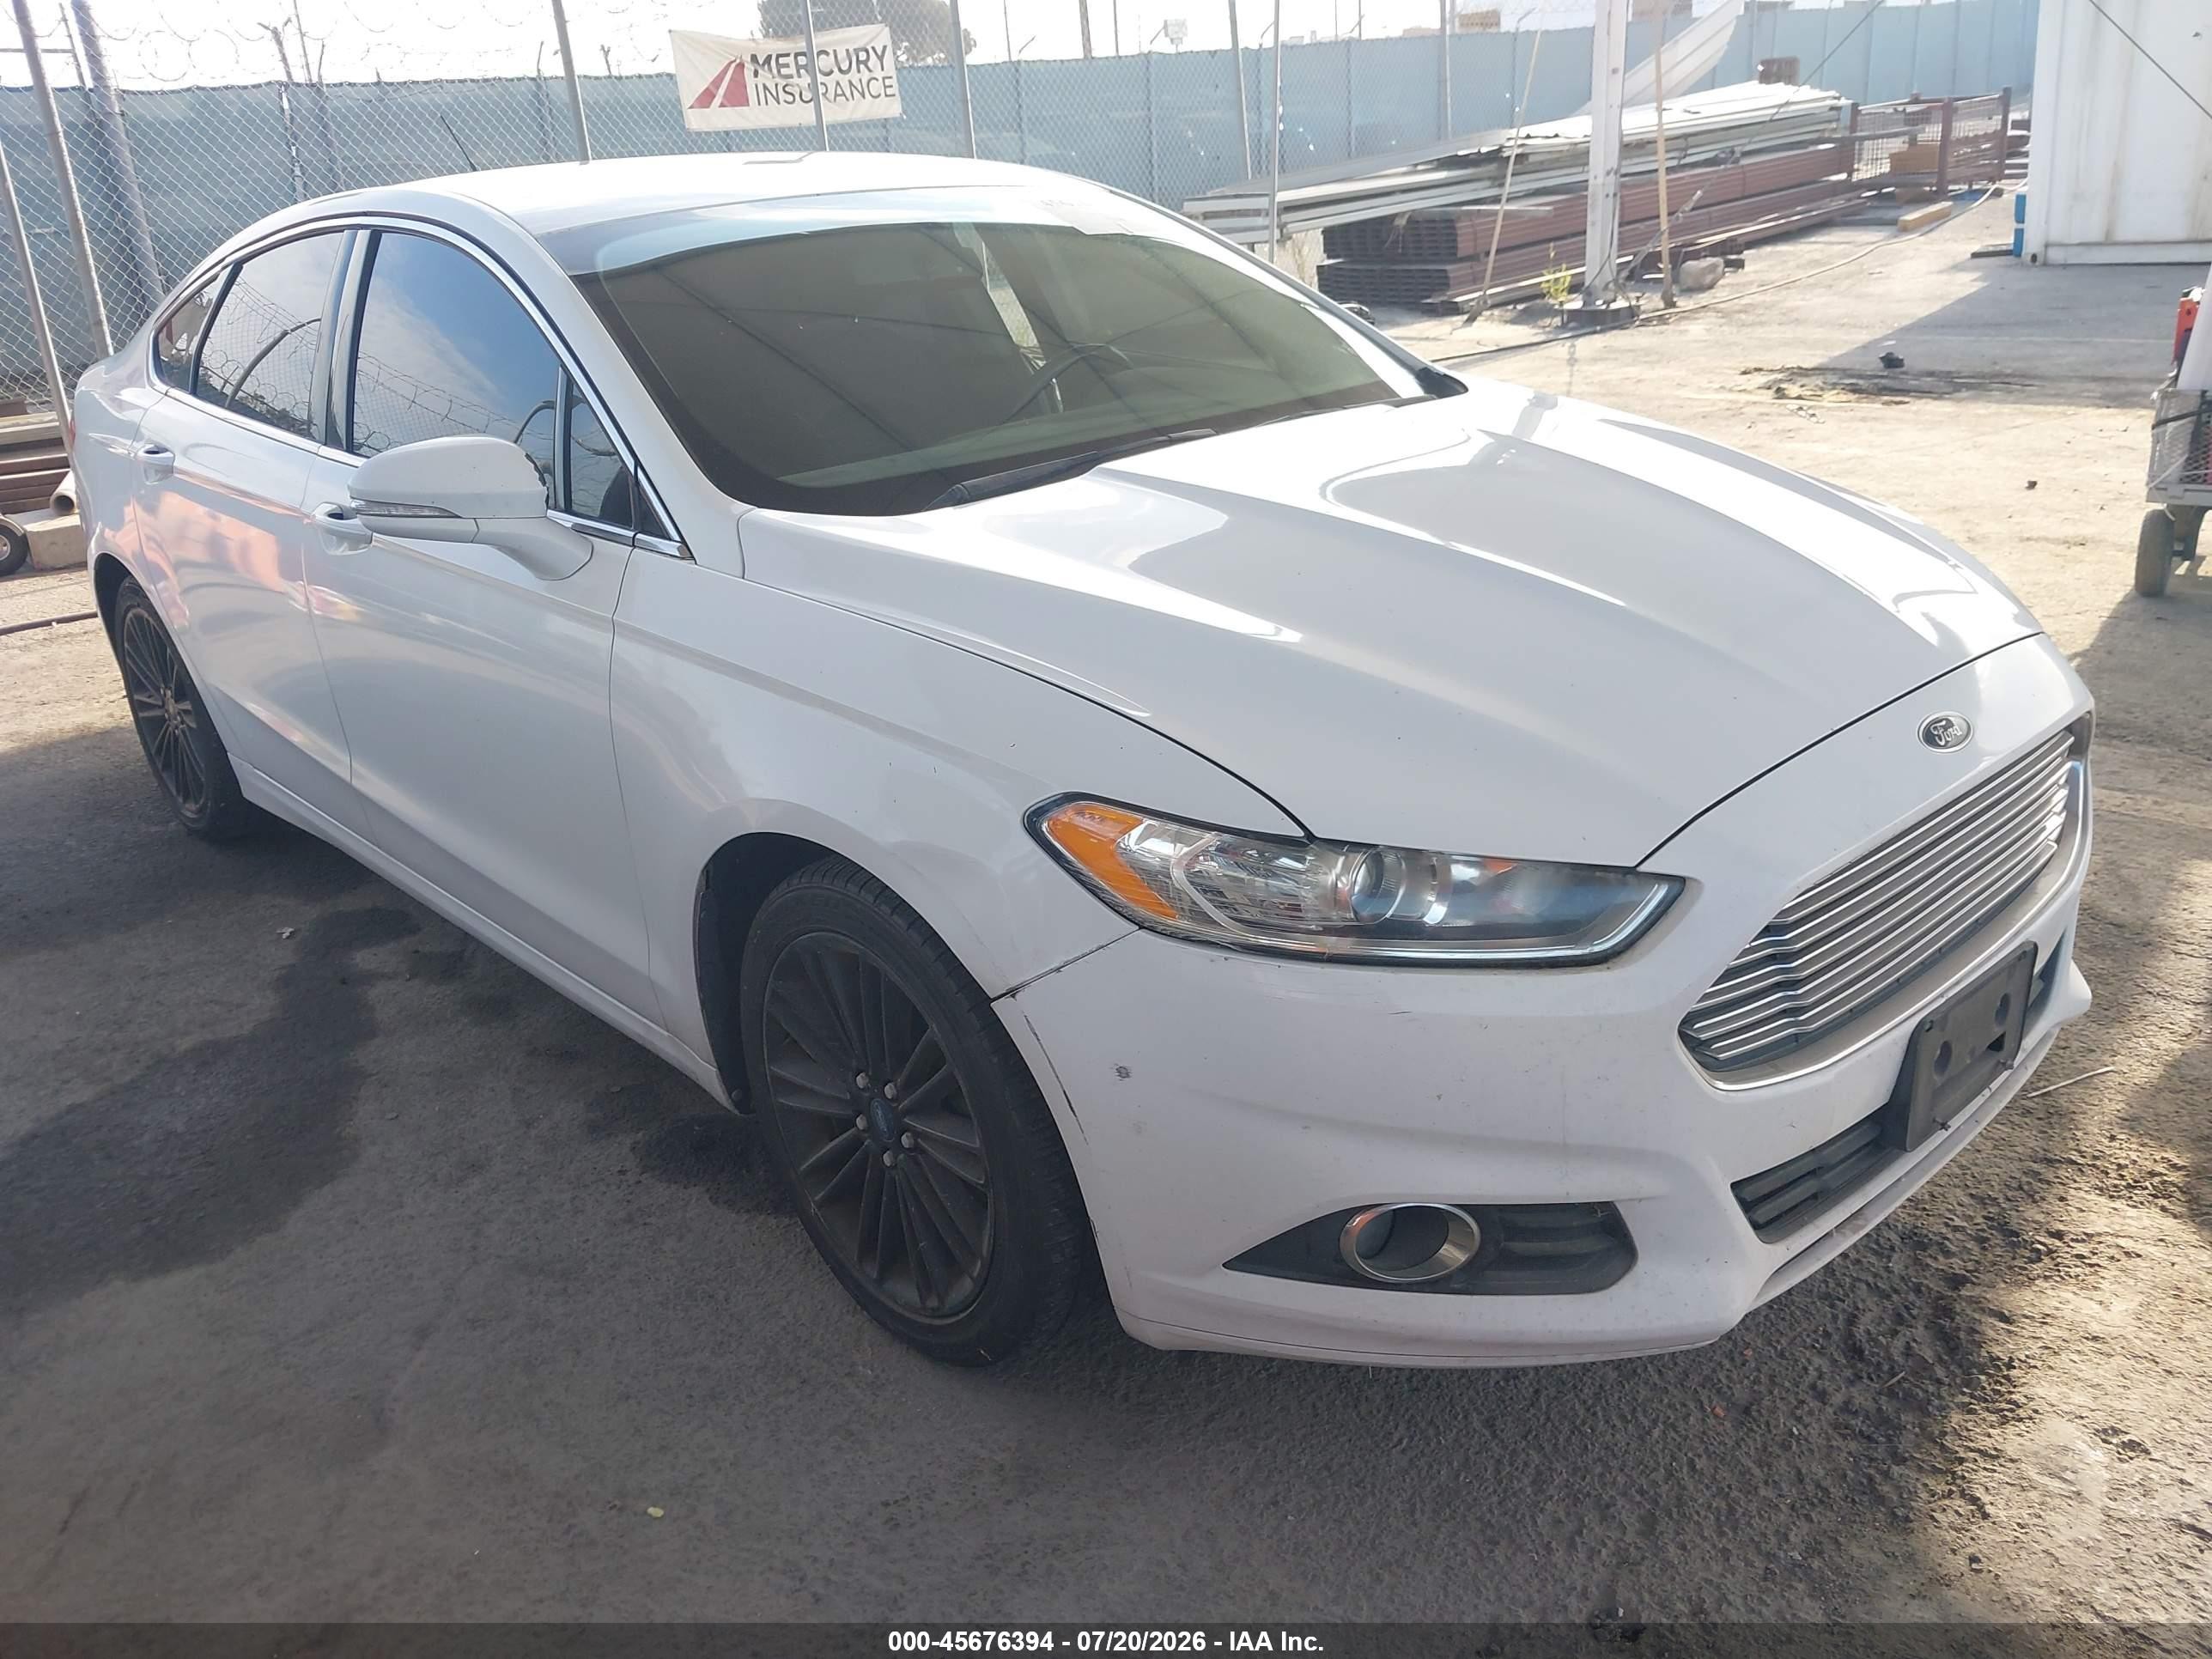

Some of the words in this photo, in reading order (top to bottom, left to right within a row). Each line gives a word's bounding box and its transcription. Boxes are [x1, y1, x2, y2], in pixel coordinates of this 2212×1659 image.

[750, 45, 888, 79] MERCURY
[754, 76, 896, 106] INSURANCE
[1929, 720, 1963, 746] Ford
